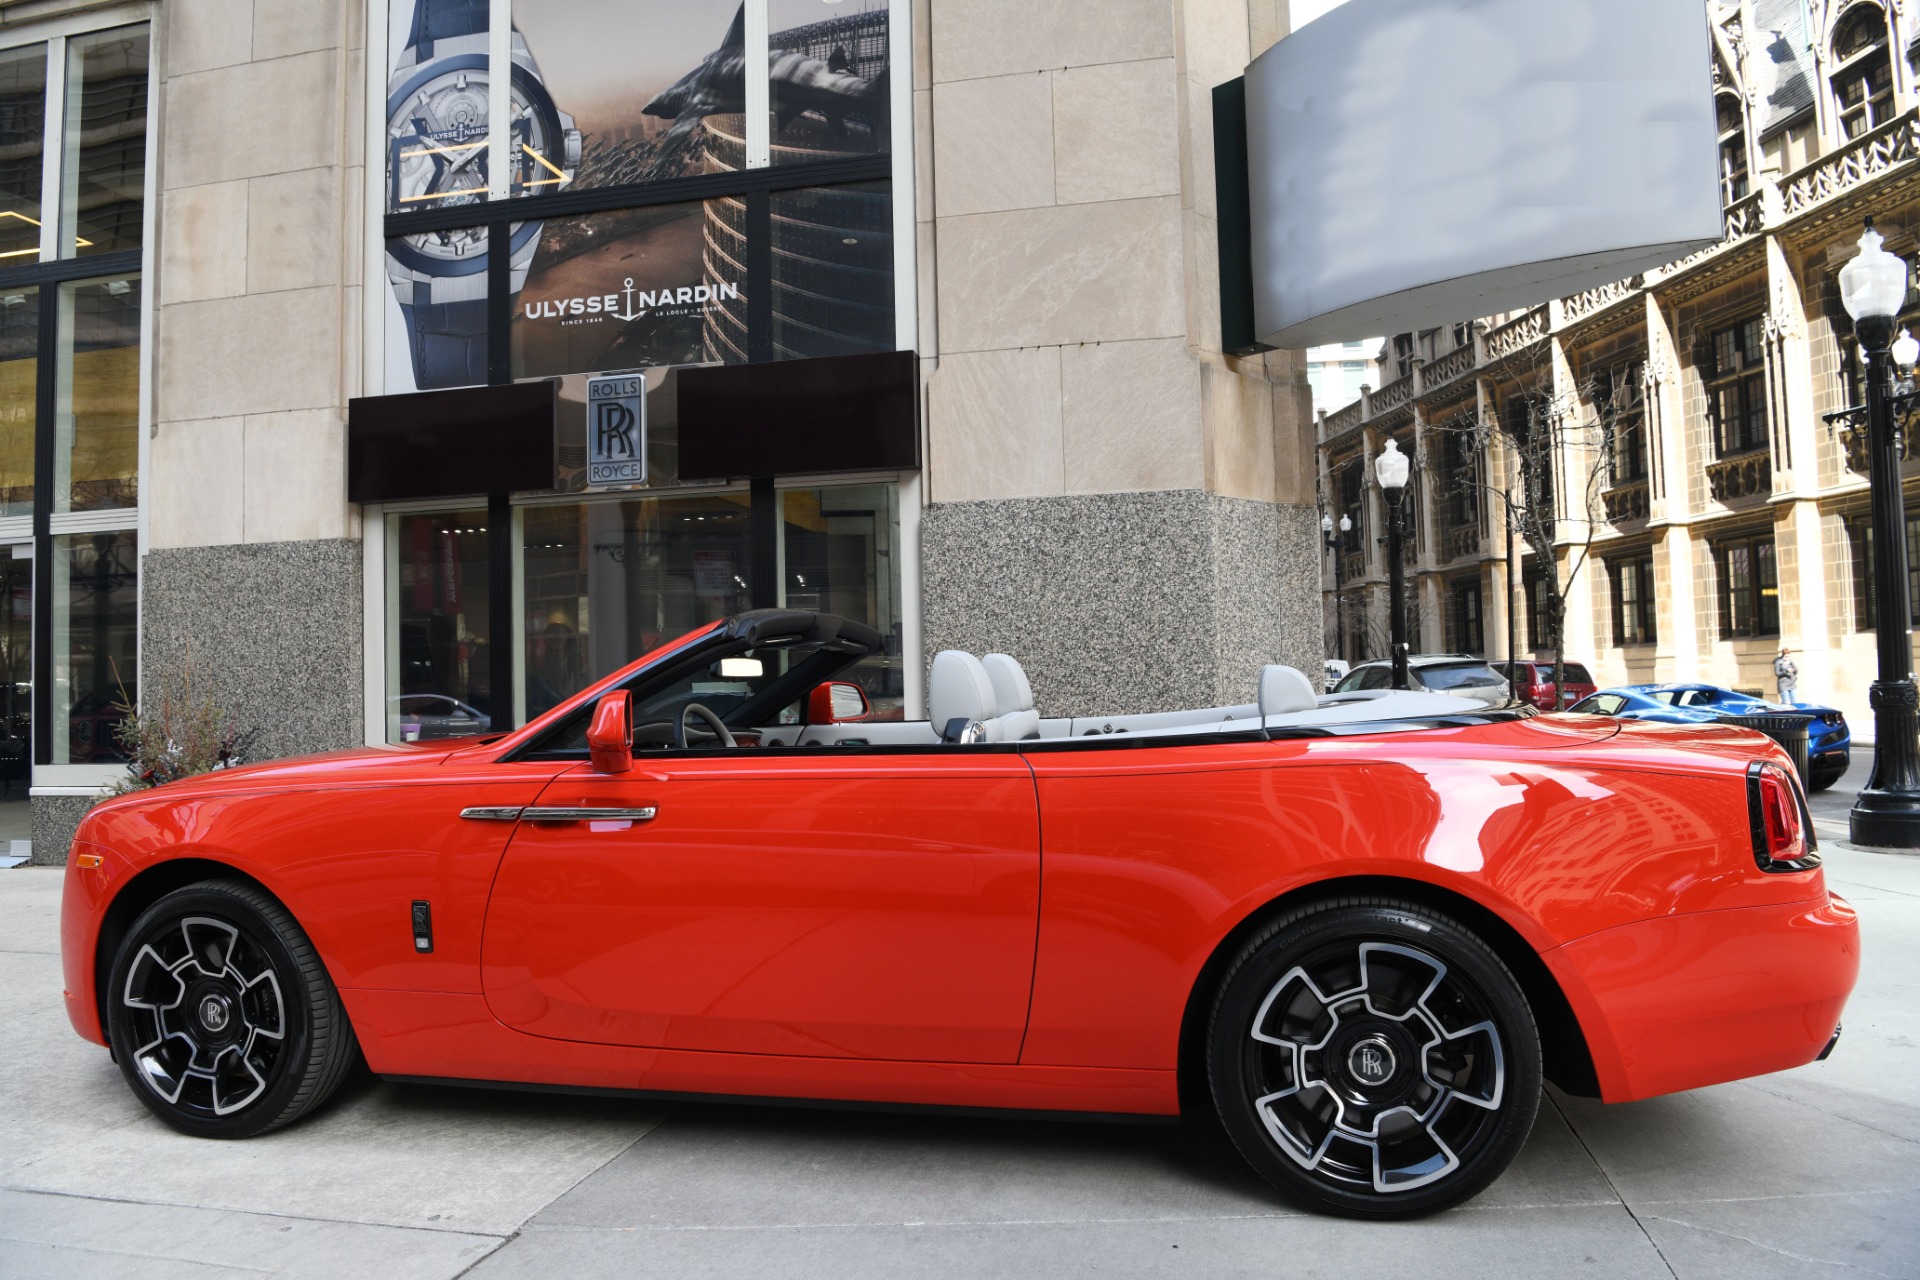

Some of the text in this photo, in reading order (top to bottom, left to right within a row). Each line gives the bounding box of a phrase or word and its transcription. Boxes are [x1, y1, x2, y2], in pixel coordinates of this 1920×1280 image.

[430, 127, 489, 140] ULYSSE NARD
[525, 282, 738, 319] ULYSSE NARDIN
[592, 381, 637, 397] ROLLS
[593, 464, 638, 478] ROYCE
